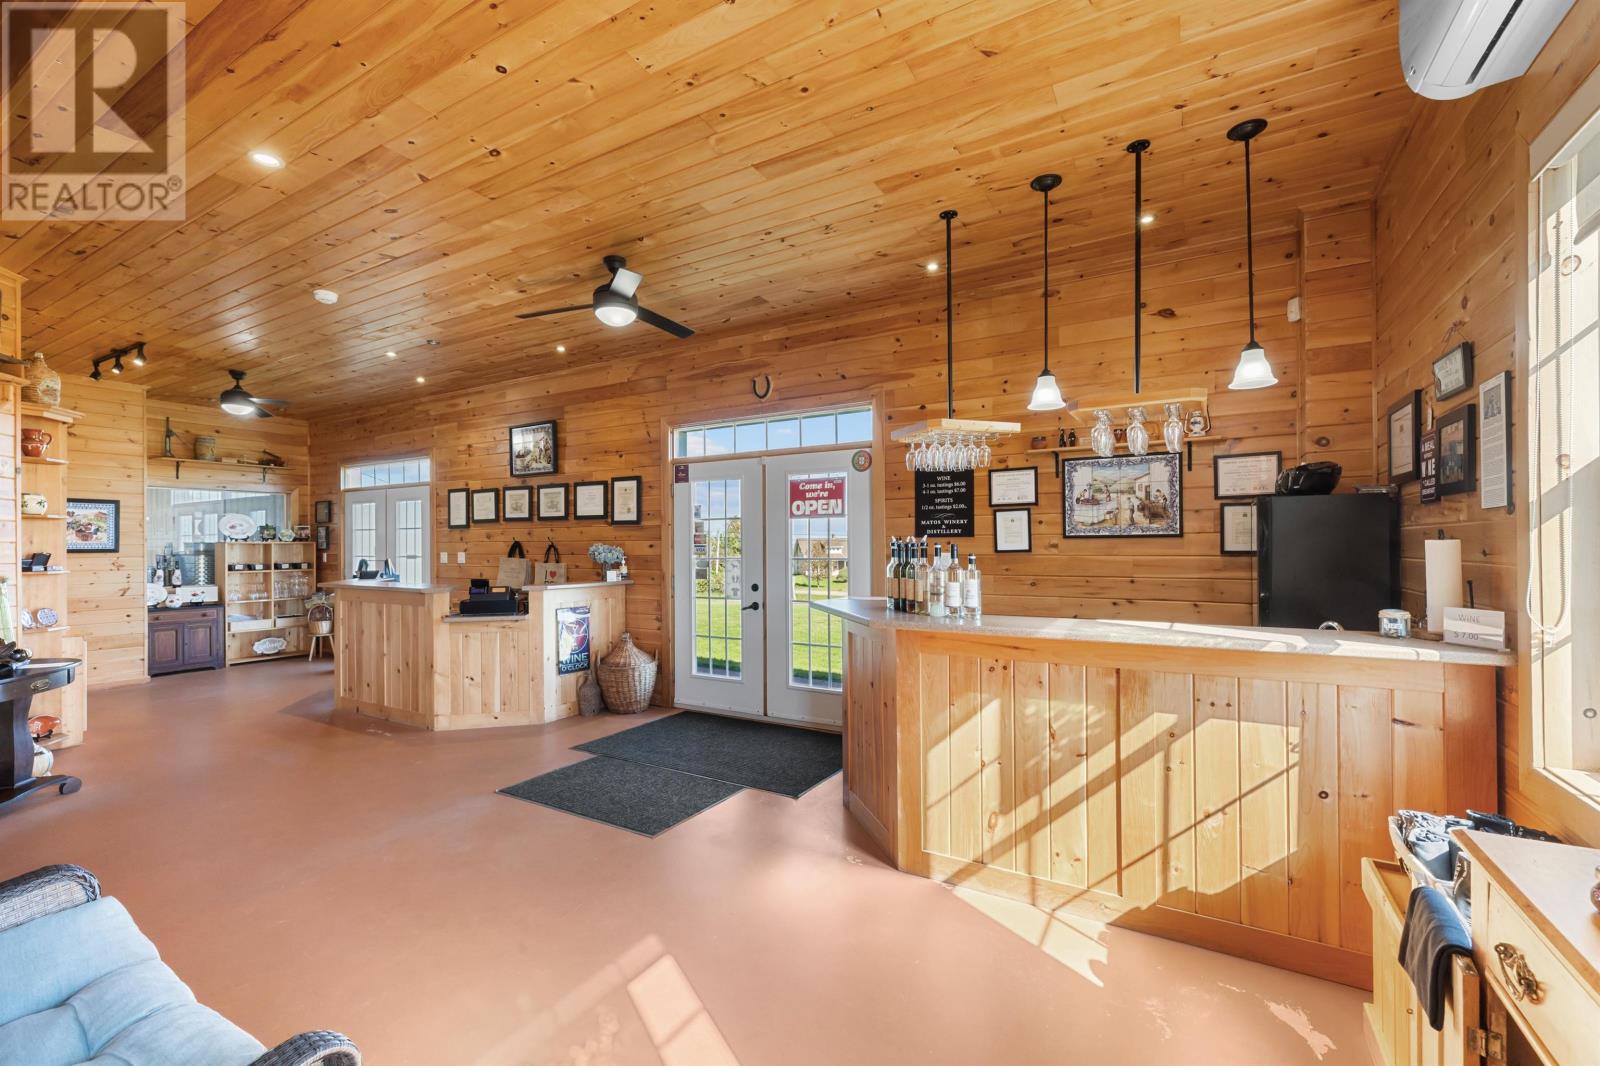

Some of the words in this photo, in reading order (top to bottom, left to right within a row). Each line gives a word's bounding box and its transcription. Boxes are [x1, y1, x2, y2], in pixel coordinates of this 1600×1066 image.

[799, 482, 823, 490] Come
[792, 499, 842, 515] OPEN
[560, 652, 589, 664] WINE
